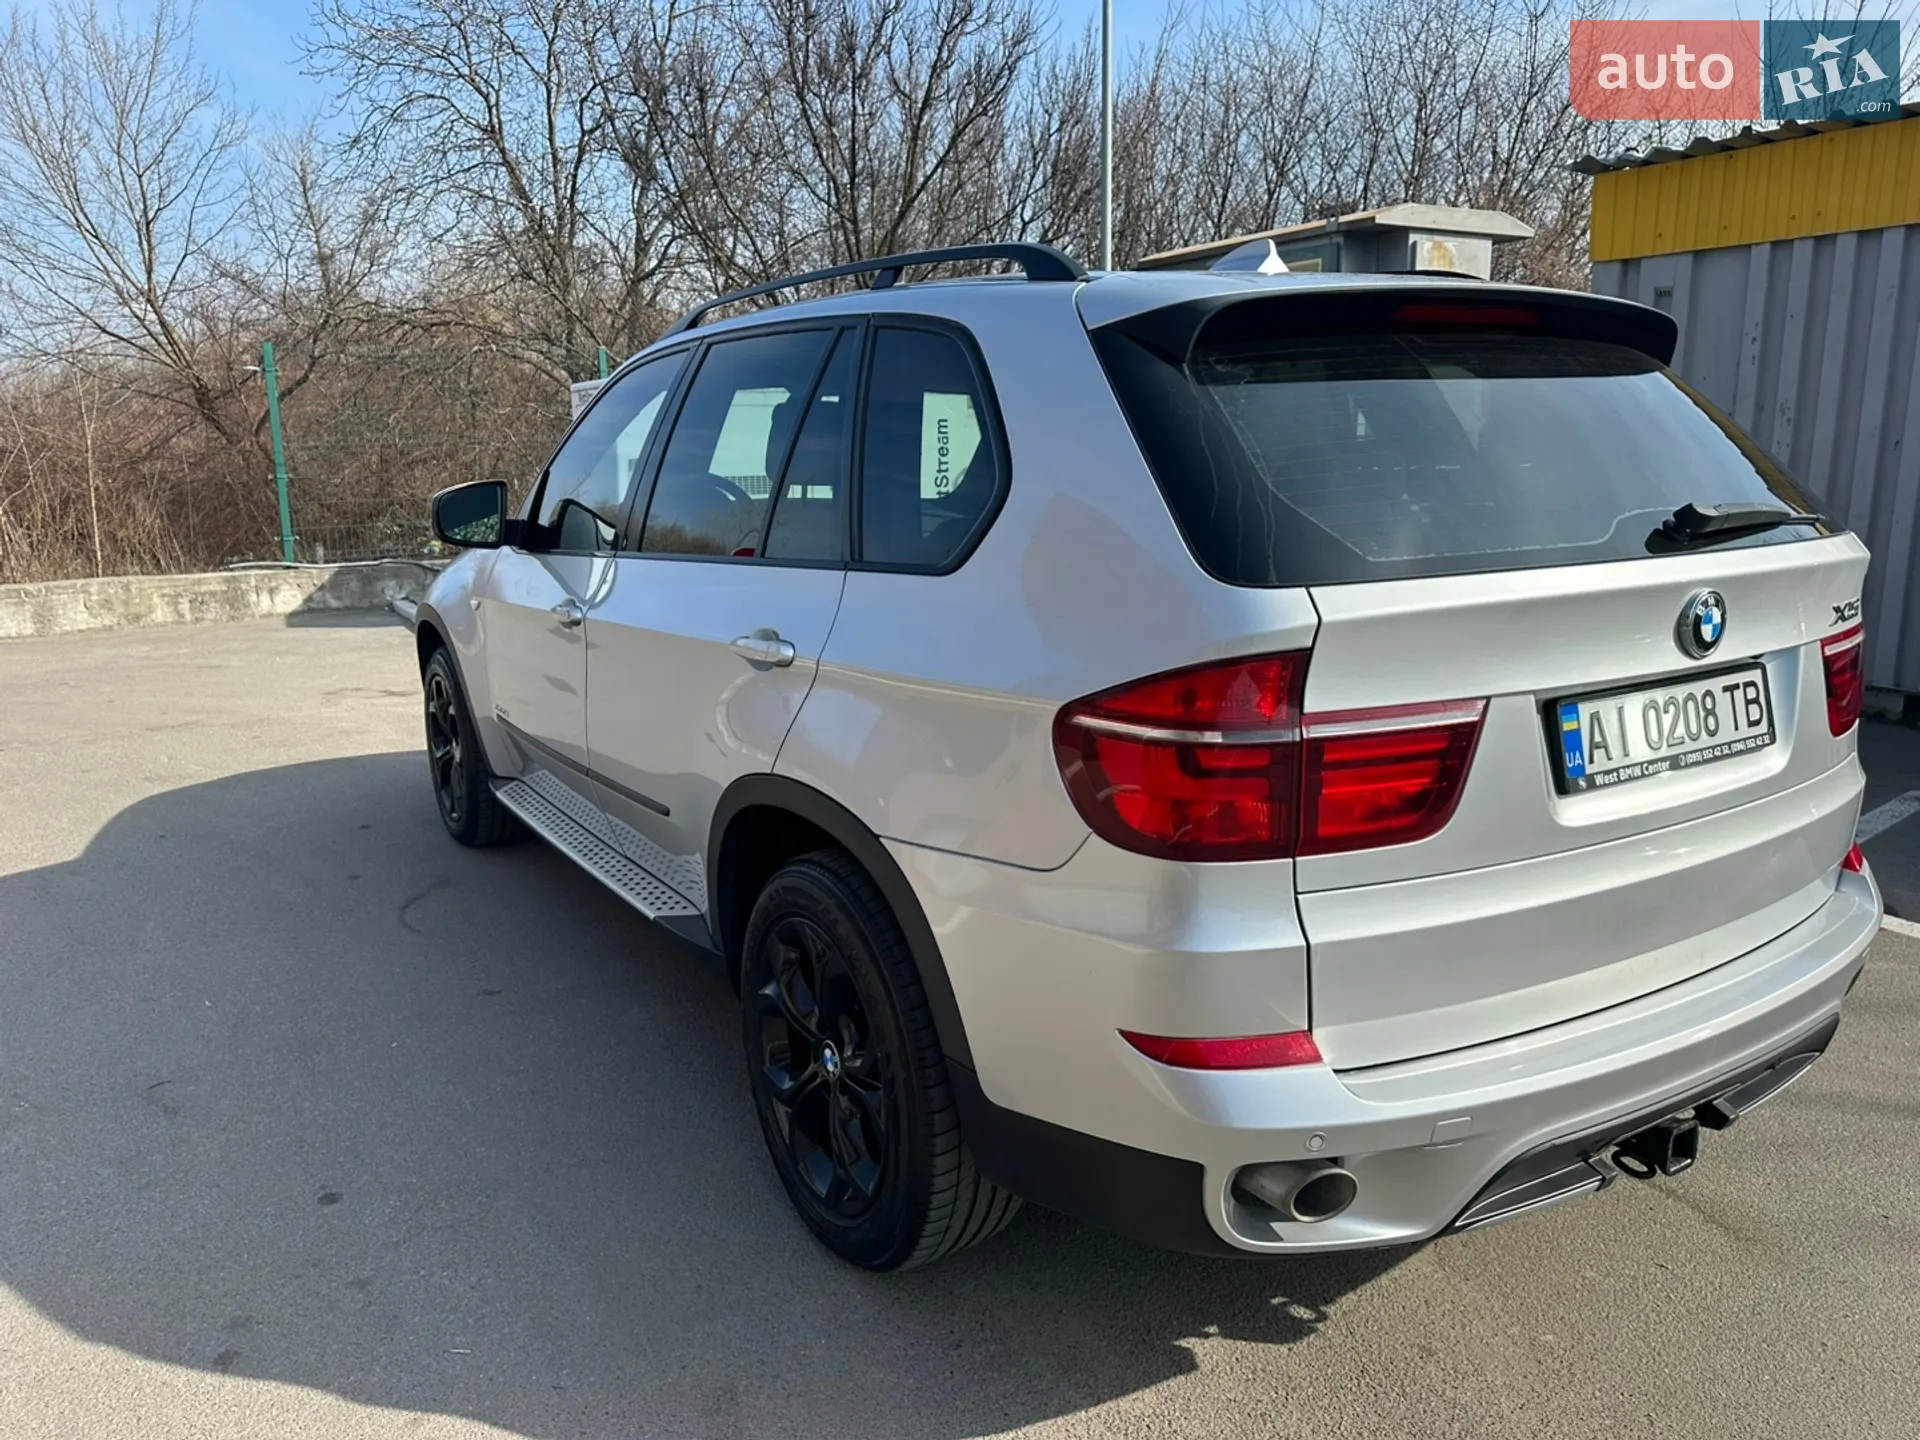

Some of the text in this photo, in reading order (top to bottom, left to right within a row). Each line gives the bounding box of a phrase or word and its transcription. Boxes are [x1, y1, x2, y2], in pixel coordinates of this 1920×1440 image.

[1829, 598, 1860, 627] X5
[1589, 680, 1764, 765] AI 0208 TB
[1565, 750, 1583, 768] UA
[1593, 771, 1619, 786] West
[1619, 763, 1642, 780] BMW
[1642, 759, 1670, 775] Center
